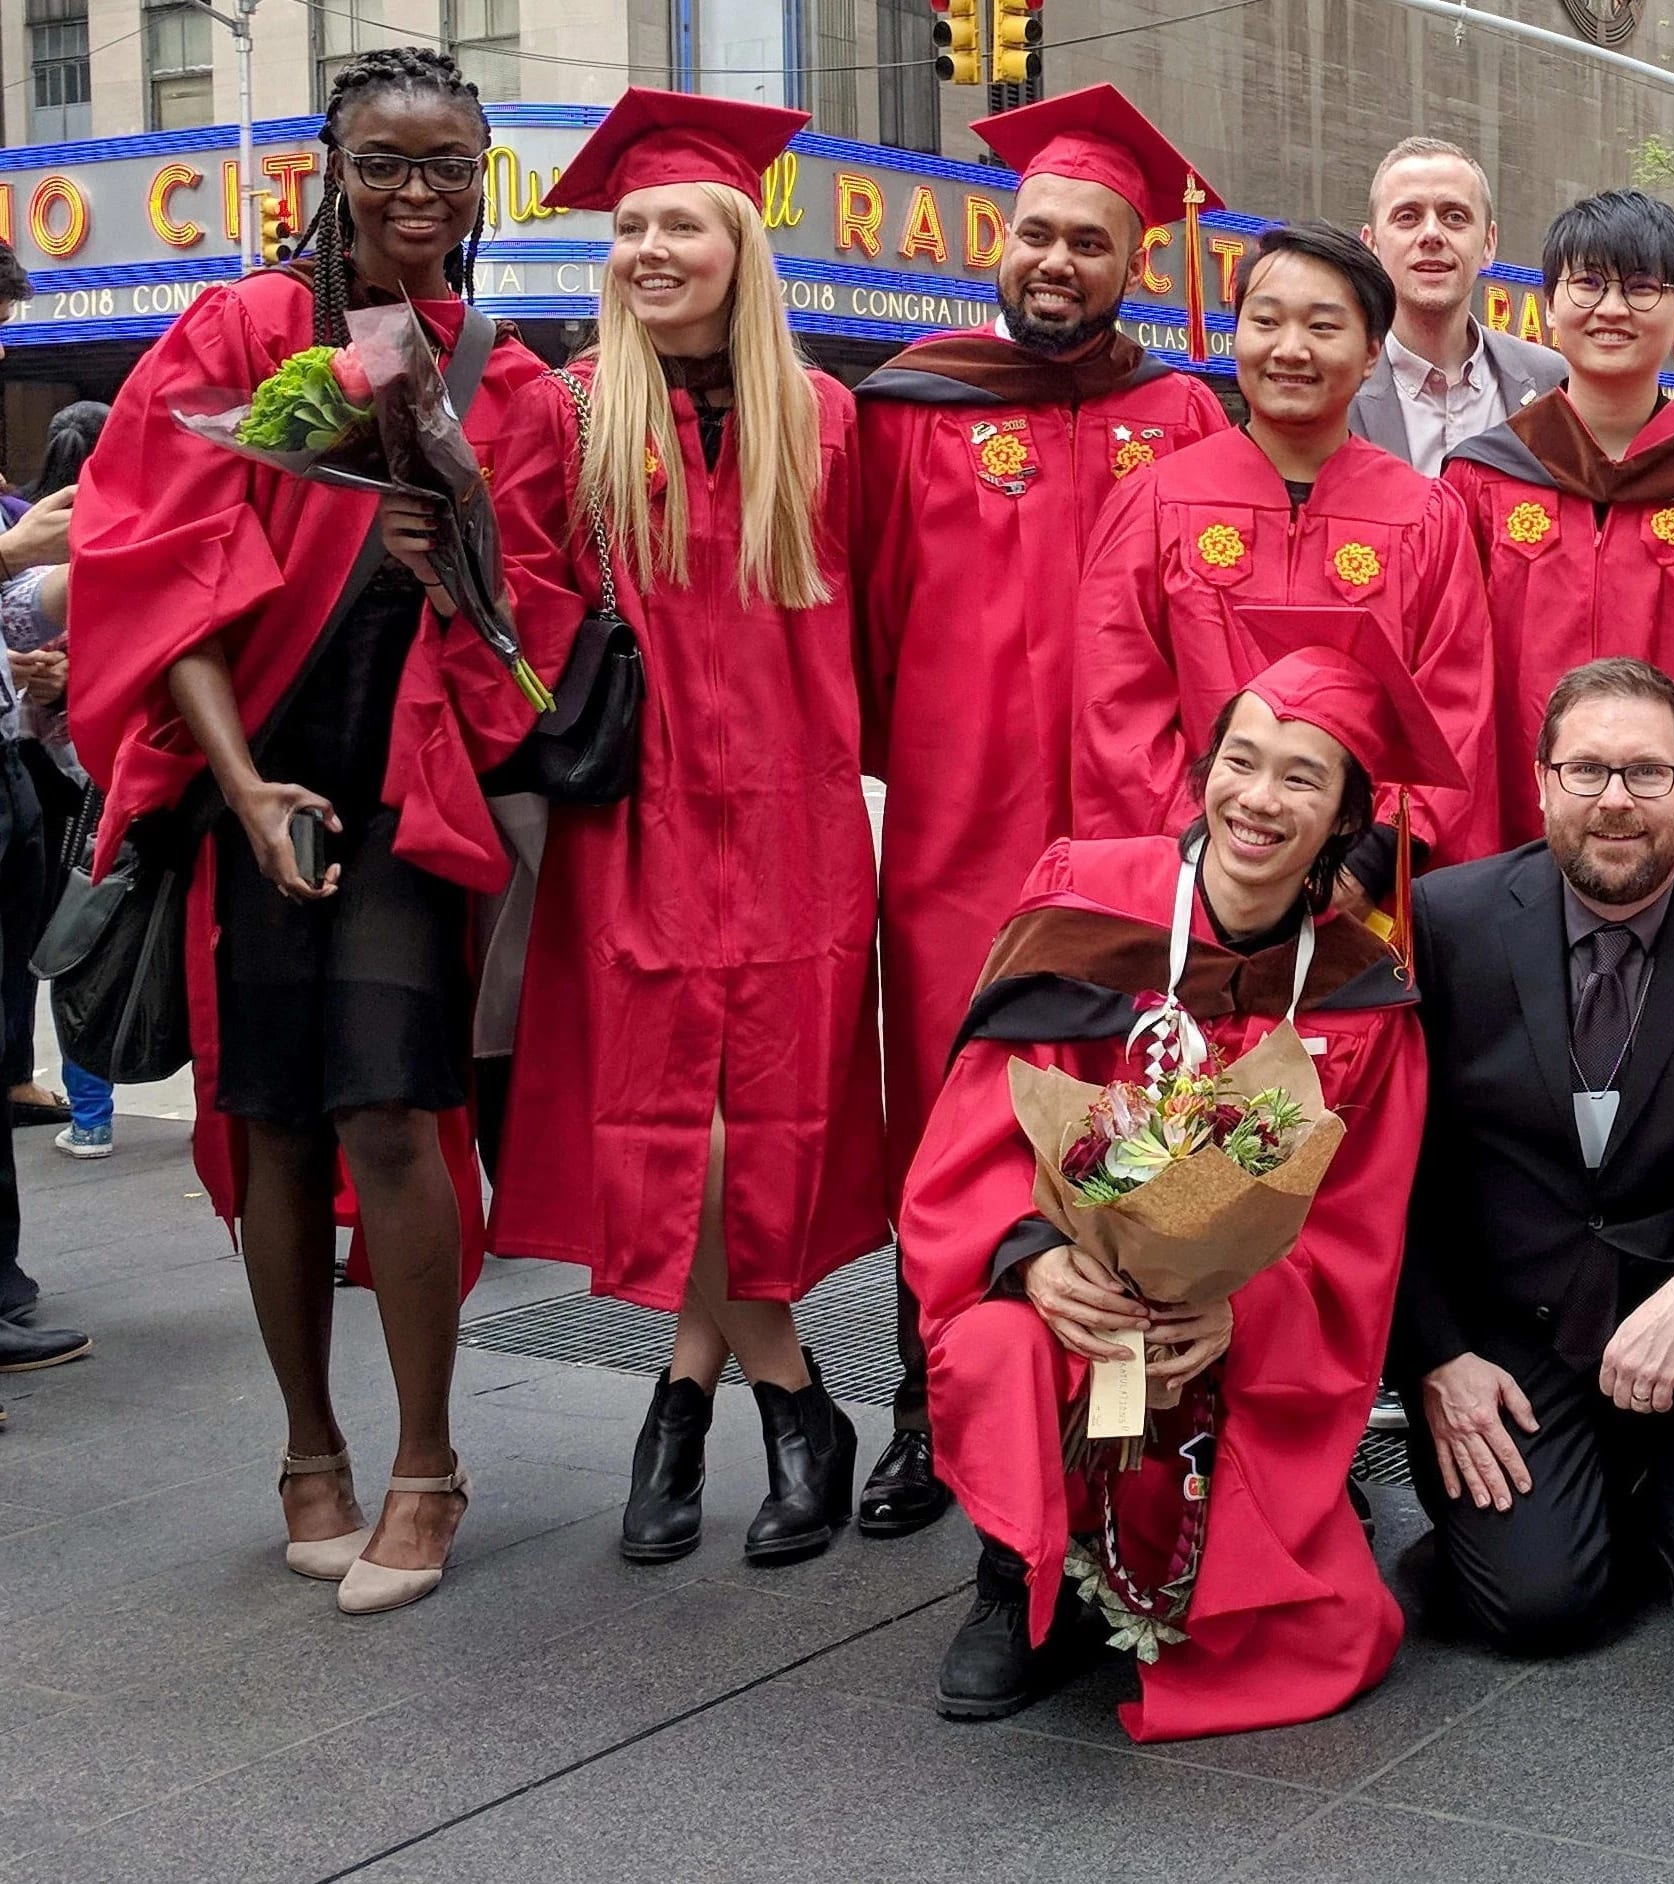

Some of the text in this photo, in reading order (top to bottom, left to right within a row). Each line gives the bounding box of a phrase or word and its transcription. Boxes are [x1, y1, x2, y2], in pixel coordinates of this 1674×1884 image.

[53, 287, 114, 320] 2018
[780, 279, 835, 311] 2018
[1211, 332, 1234, 356] OF
[1002, 419, 1026, 433] 2018
